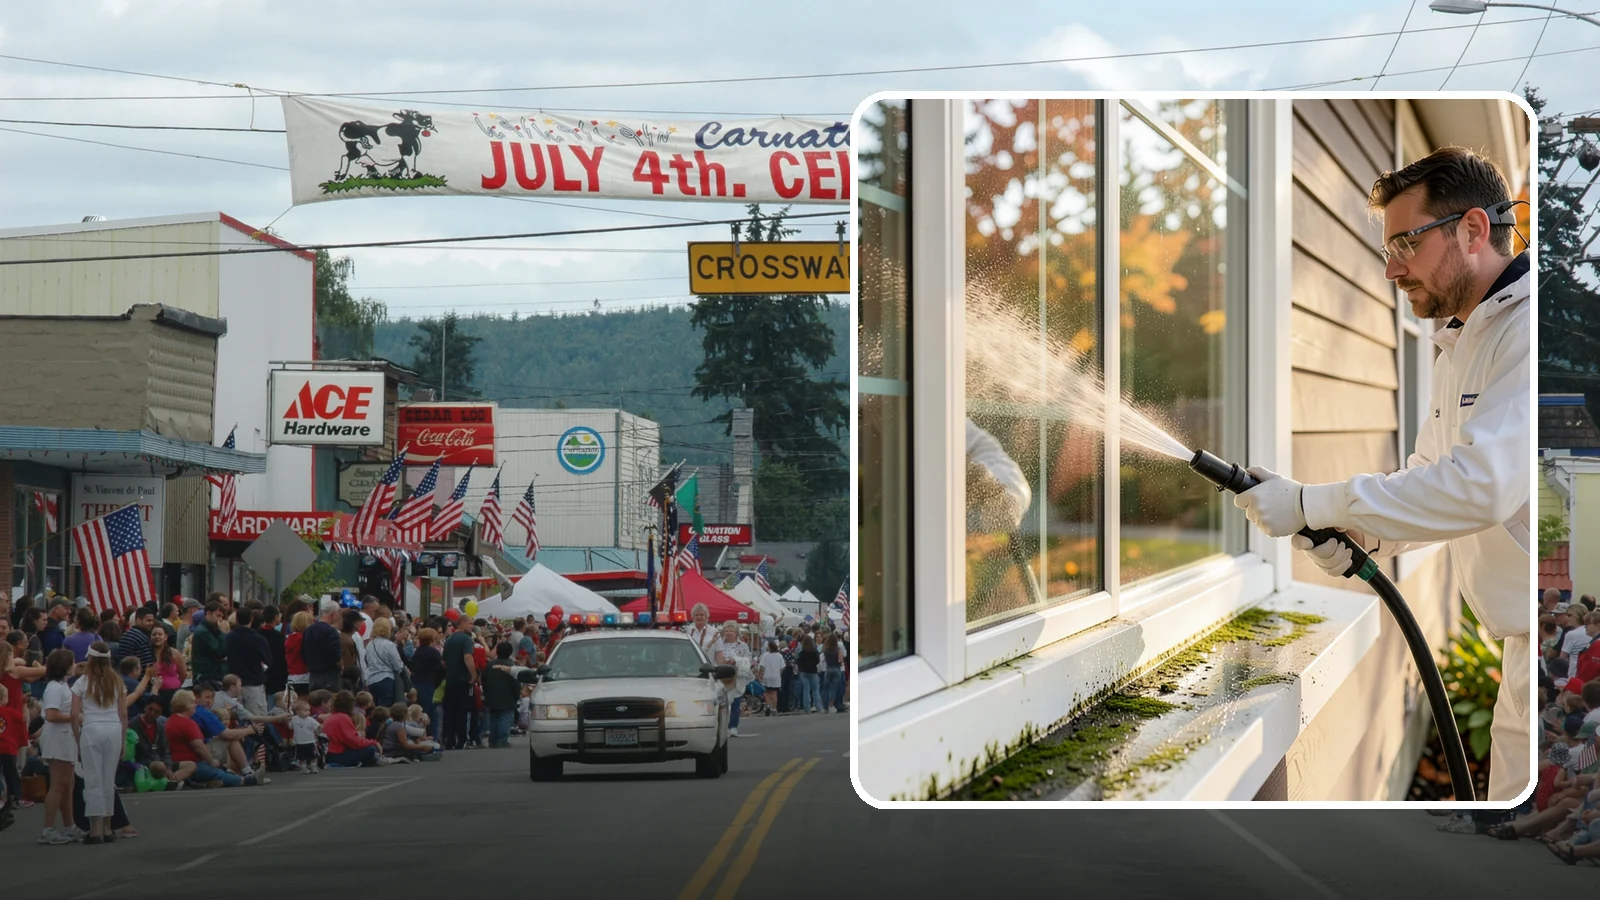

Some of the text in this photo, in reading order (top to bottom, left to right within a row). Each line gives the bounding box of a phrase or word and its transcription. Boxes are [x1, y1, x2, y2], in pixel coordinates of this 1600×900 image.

[695, 121, 850, 150] Carnat
[481, 141, 605, 192] JULY
[633, 150, 747, 198] 4th.
[697, 254, 850, 280] CROSSWA
[283, 380, 373, 420] ACE
[406, 409, 452, 422] CEDAR
[283, 421, 370, 436] Hardware
[416, 428, 477, 446] Coca-Cola
[95, 485, 124, 494] Vincent
[126, 486, 136, 494] de
[137, 486, 155, 495] Paul
[688, 526, 741, 535] CRNATION
[699, 535, 730, 543] GLASS
